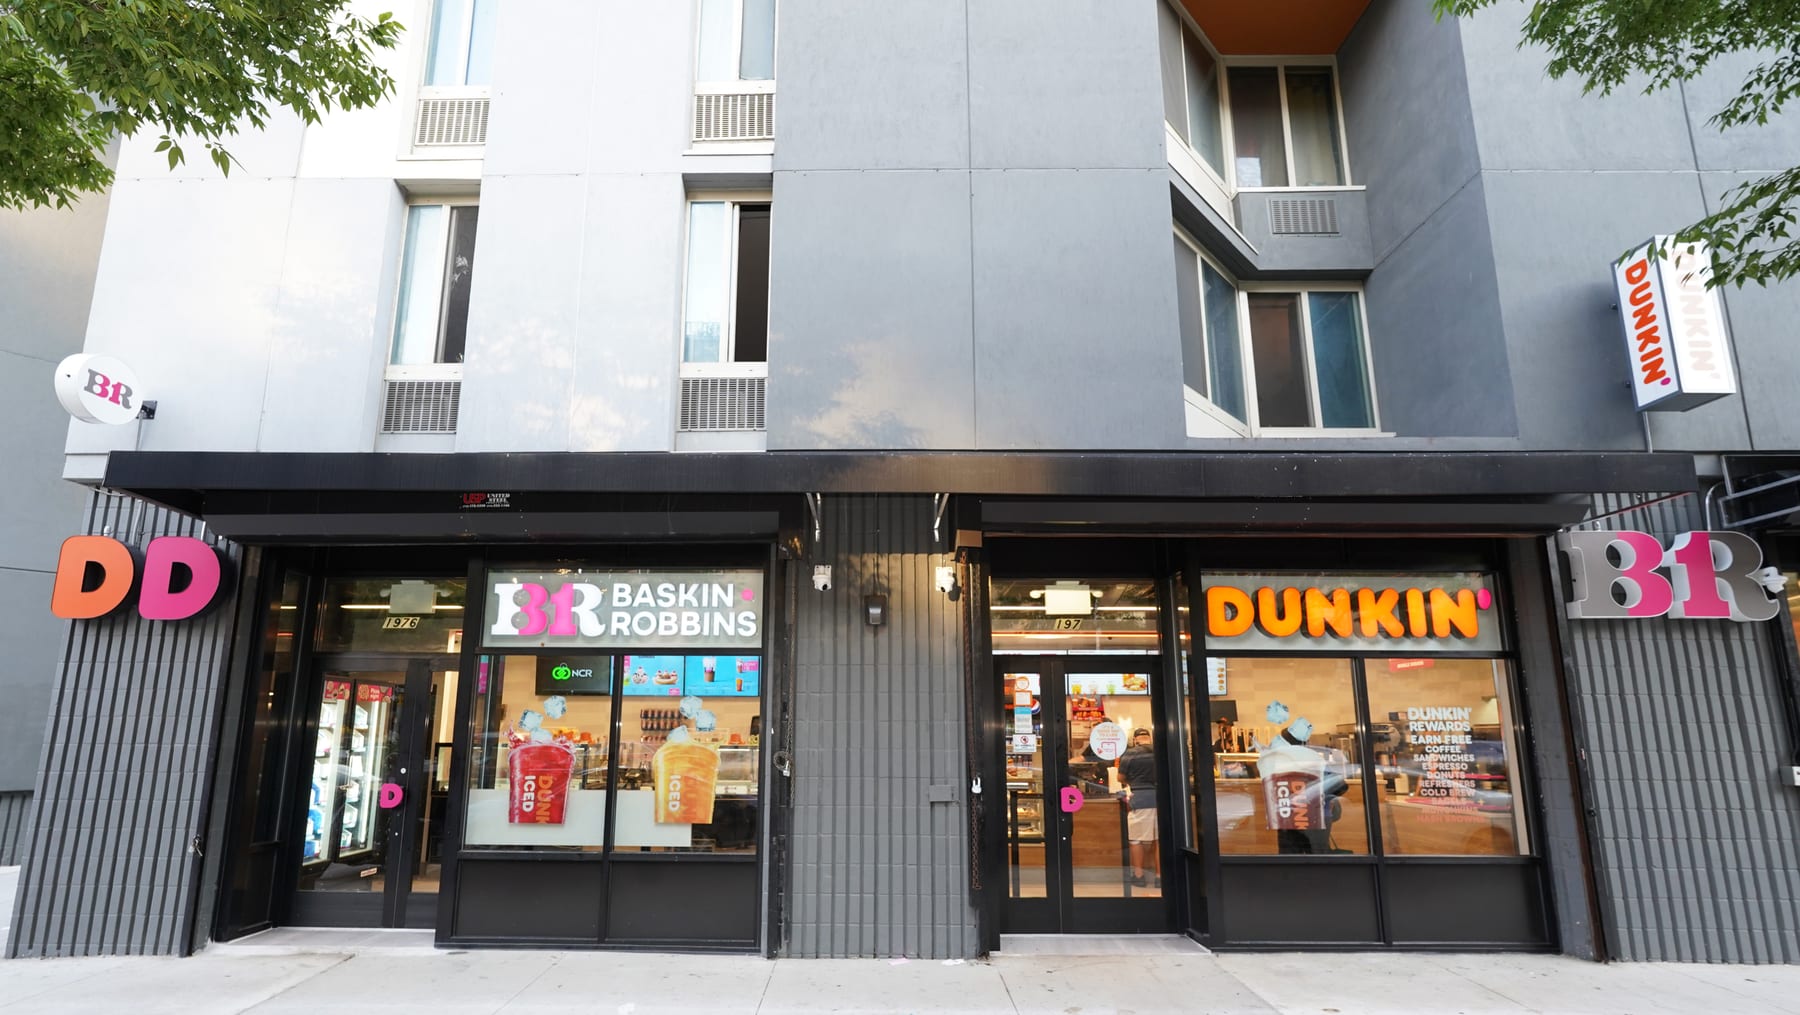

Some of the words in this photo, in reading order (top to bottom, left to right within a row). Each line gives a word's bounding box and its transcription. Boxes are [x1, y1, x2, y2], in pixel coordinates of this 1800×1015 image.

[1625, 259, 1671, 386] DUNKIN'
[612, 583, 735, 608] BASKIN
[1206, 586, 1492, 639] DUNKIN'
[385, 617, 418, 629] 1976
[611, 611, 757, 637] ROBBINS
[1056, 619, 1081, 630] 197
[571, 669, 592, 678] NCR
[1407, 706, 1472, 720] DUNKIN'
[1409, 721, 1471, 732] REWARDS
[1410, 734, 1442, 745] EARN
[1444, 734, 1472, 745] FREE
[1425, 745, 1462, 754] COFFEE
[1413, 754, 1475, 762] SANDWICHES
[1422, 762, 1468, 770] ESPRESSO
[1426, 771, 1466, 780] DONUTS
[1419, 780, 1476, 788] REFRESHERS
[380, 783, 404, 809] D
[522, 775, 536, 812] ICED
[668, 775, 682, 812] ICED
[1420, 788, 1447, 796] COLD
[1449, 788, 1476, 796] BREW
[1060, 786, 1084, 812] D
[1277, 781, 1292, 818] ICED
